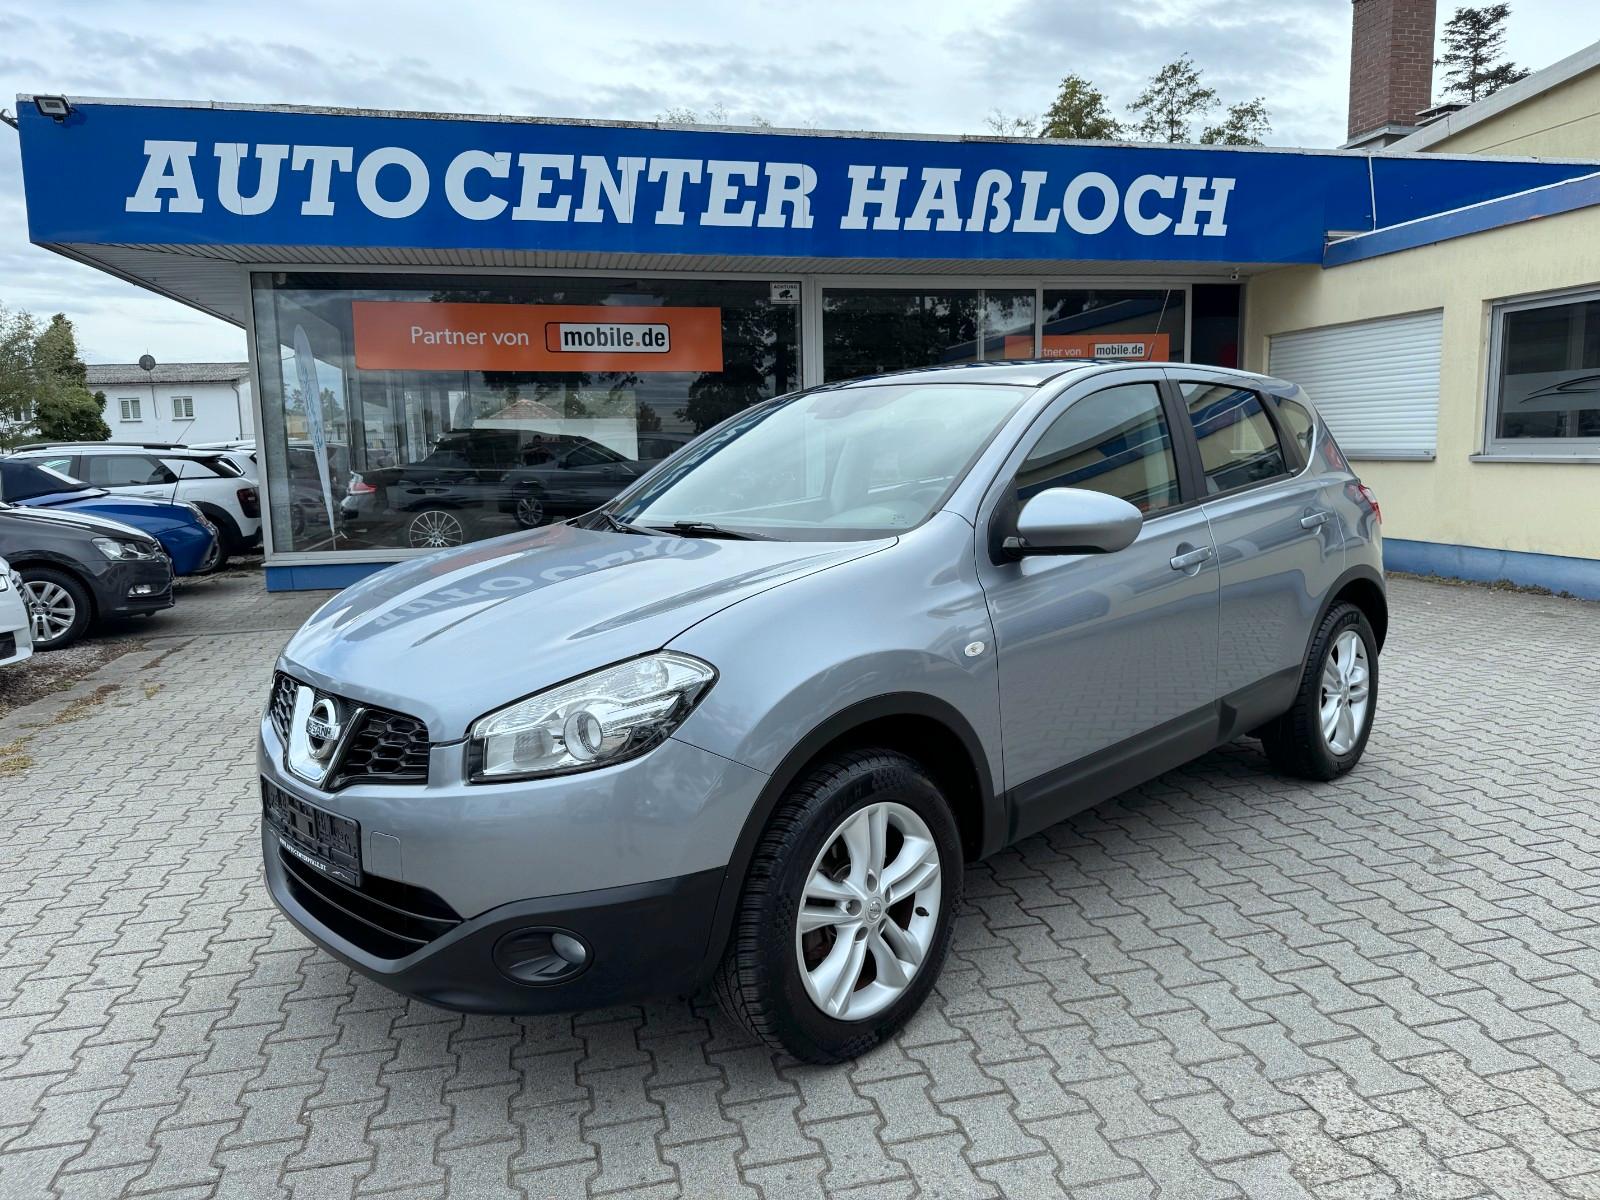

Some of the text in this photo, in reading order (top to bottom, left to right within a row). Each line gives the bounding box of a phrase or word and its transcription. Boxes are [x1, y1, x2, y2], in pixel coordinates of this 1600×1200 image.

[125, 140, 1236, 237] AUTO CENTER HAßLOCH
[410, 326, 666, 348] Partner von mobile.de
[1064, 348, 1082, 356] von
[1096, 344, 1144, 356] mobile.de
